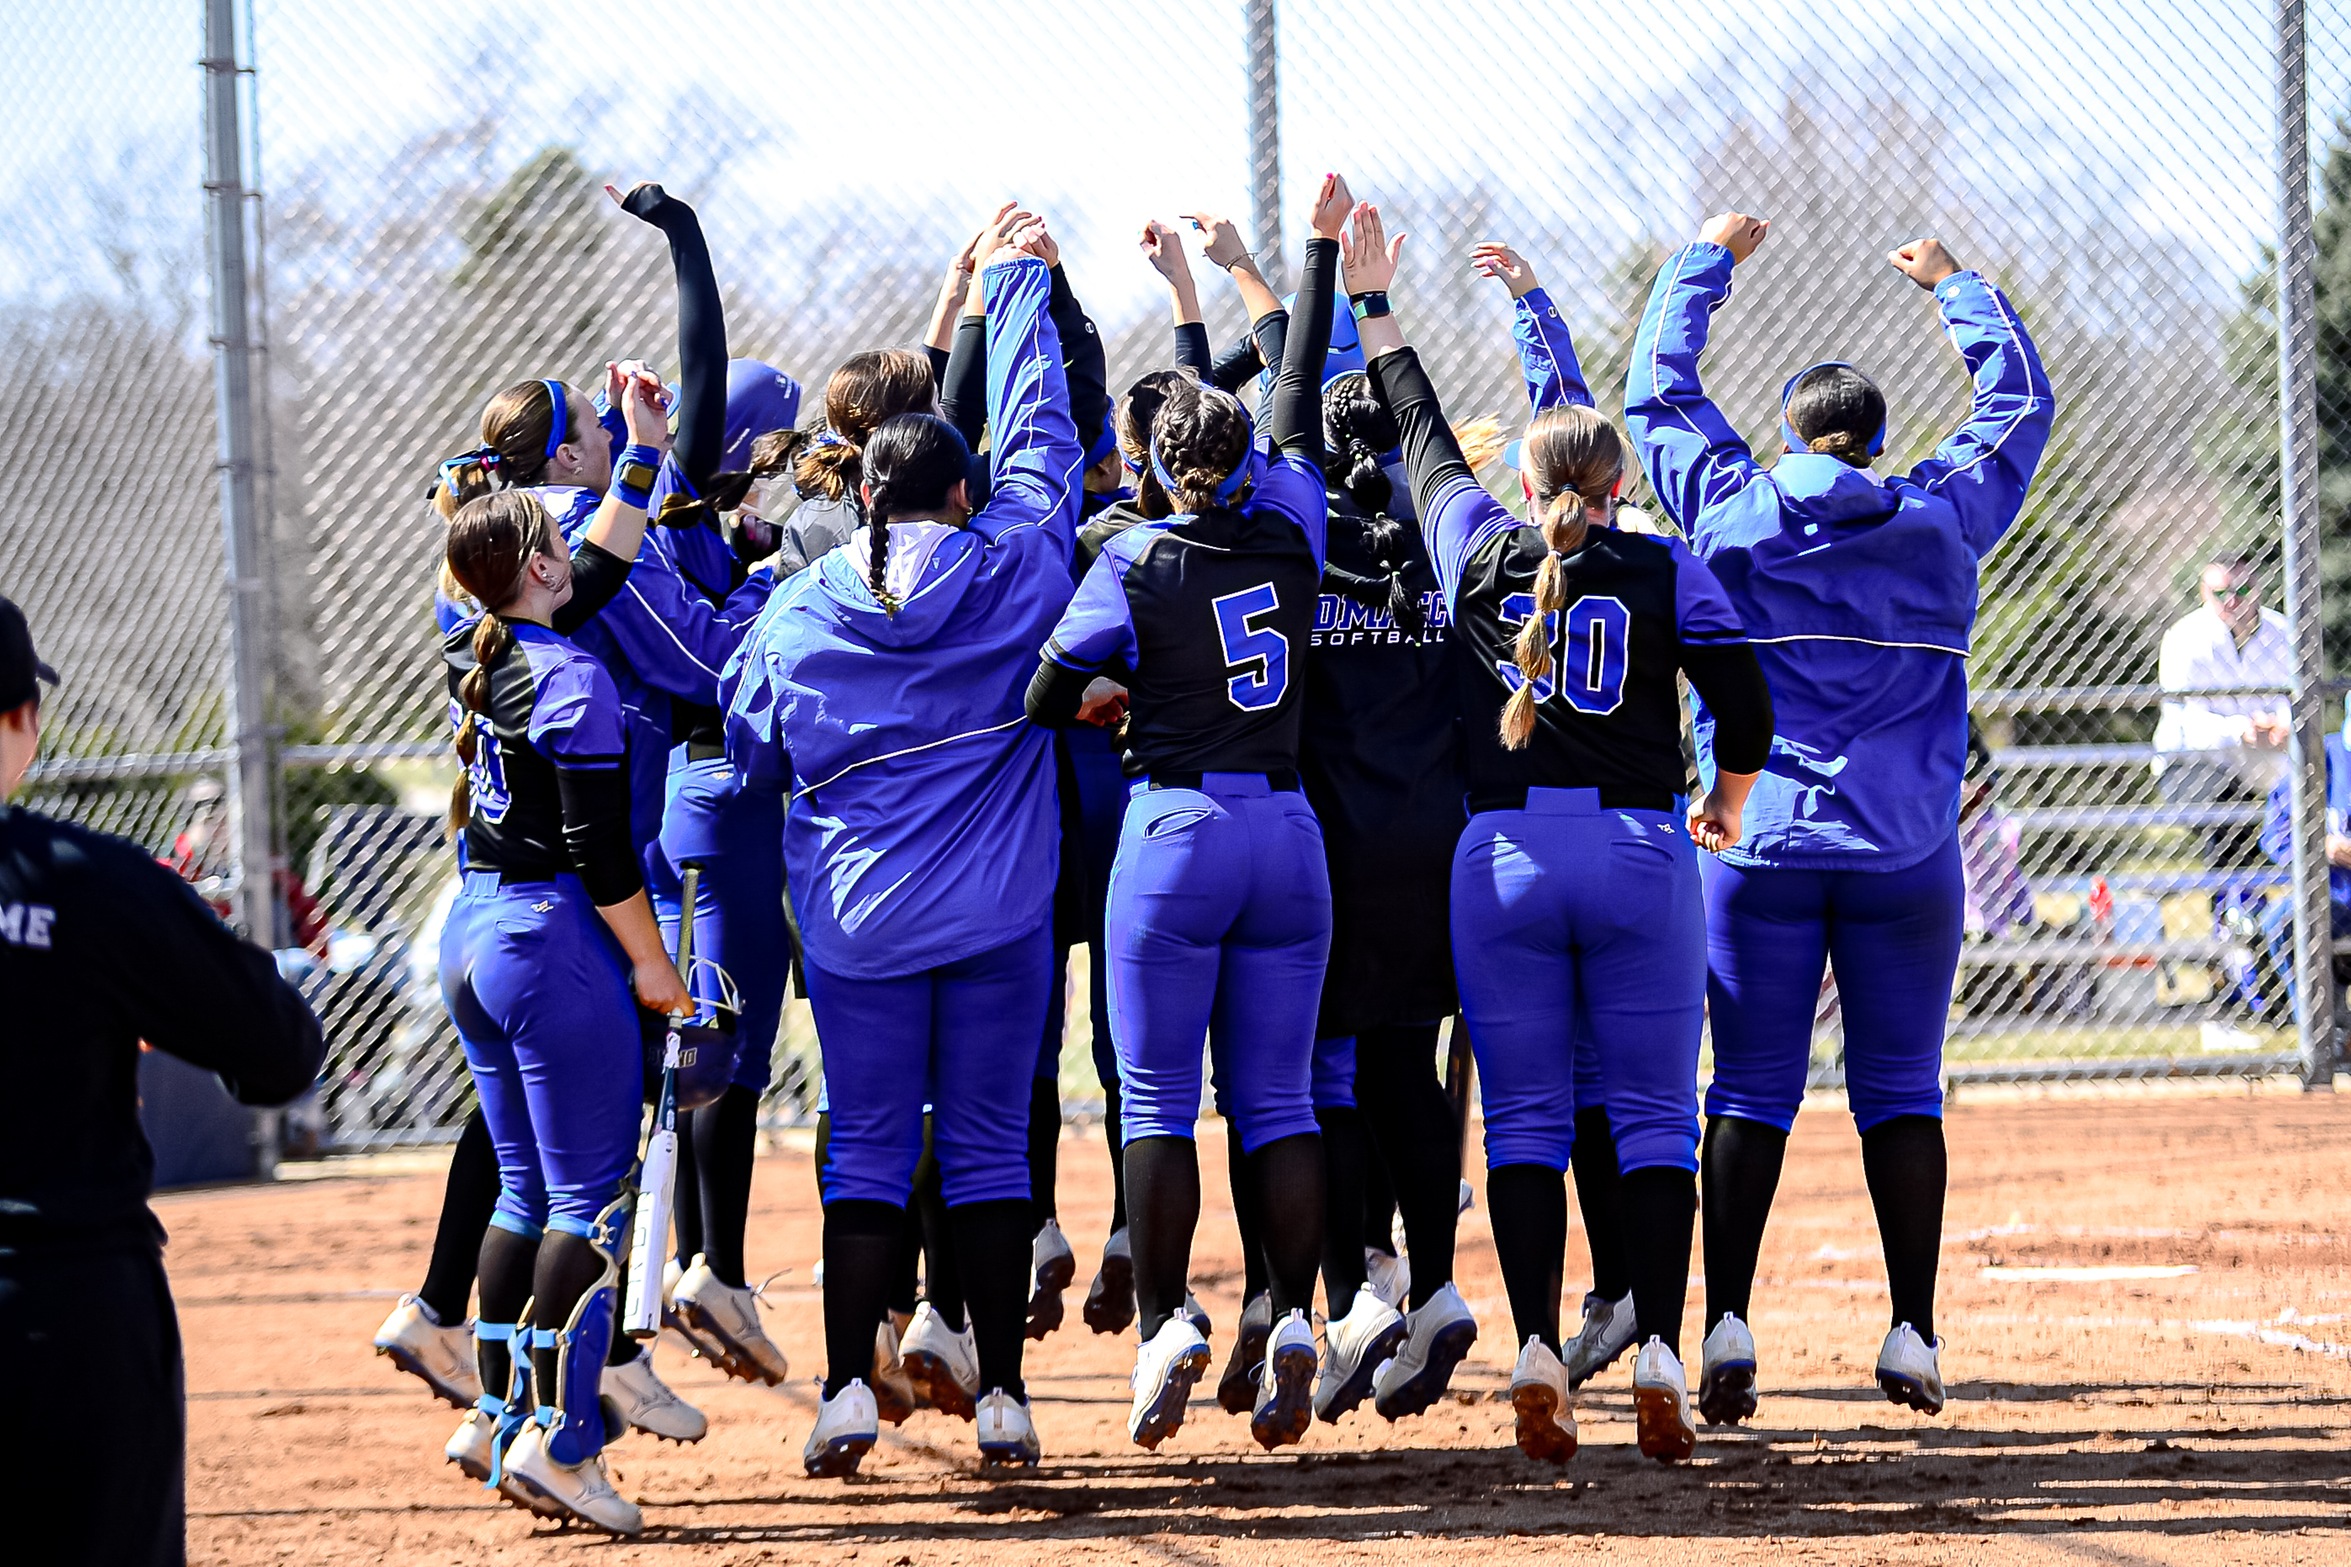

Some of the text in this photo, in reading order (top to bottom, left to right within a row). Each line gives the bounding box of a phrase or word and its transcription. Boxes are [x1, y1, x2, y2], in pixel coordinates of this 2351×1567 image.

[1211, 581, 1289, 712] 5
[1310, 630, 1444, 646] SOFTBALL
[1496, 592, 1631, 716] 30
